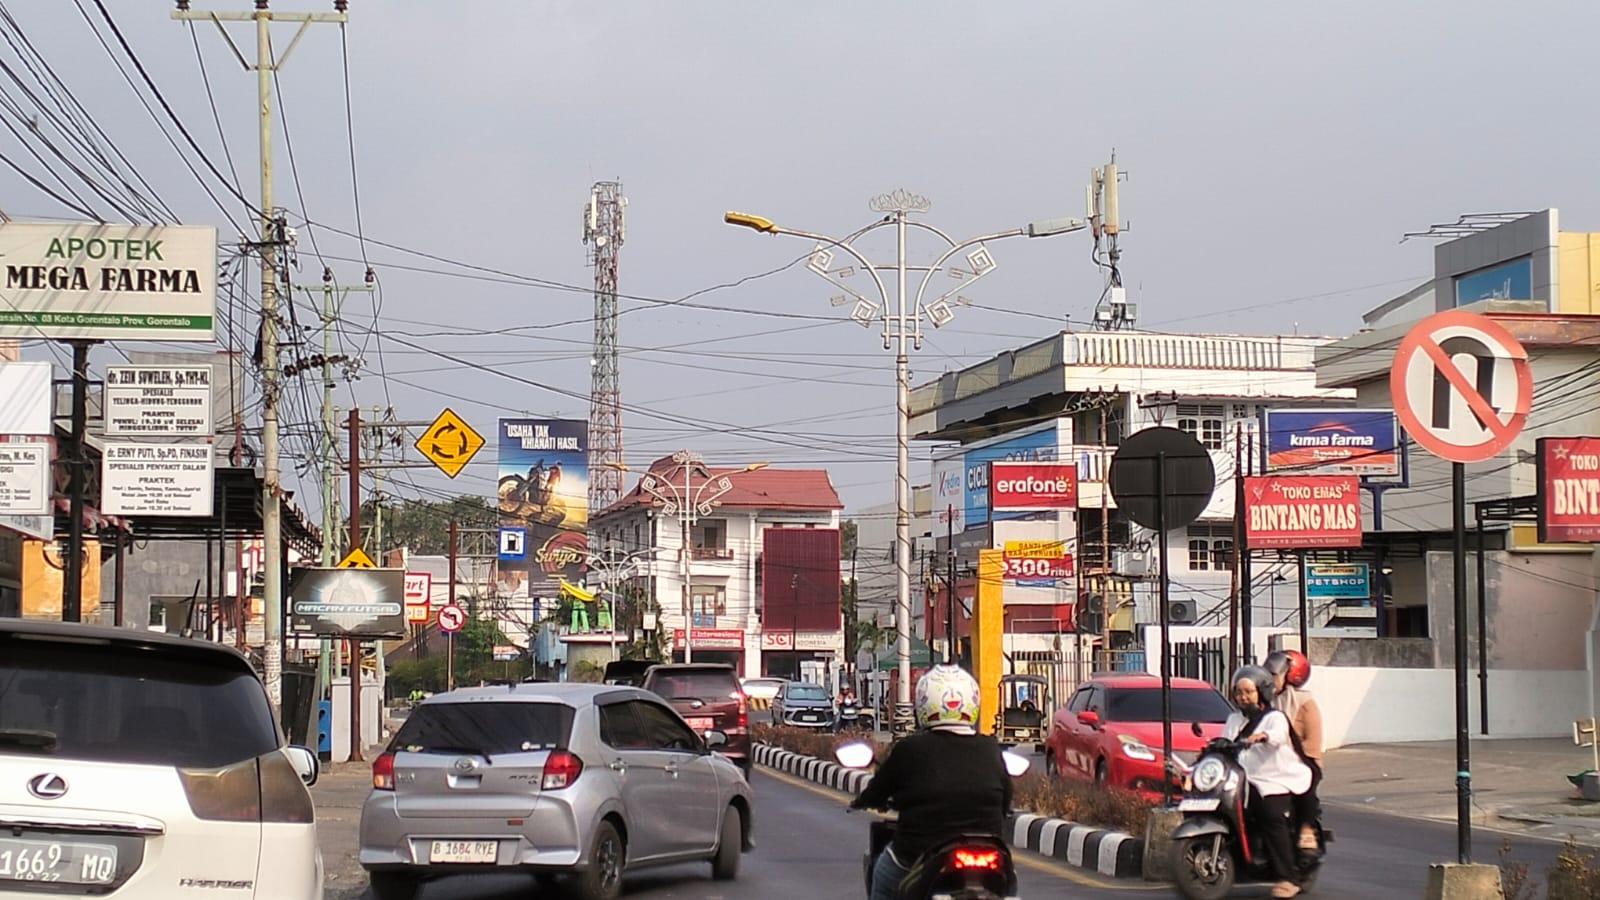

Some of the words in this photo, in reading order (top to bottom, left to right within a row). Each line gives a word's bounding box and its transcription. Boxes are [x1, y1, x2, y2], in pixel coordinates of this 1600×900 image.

[45, 238, 164, 261] APOTEK
[6, 265, 89, 290] MEGA
[100, 267, 201, 293] FARMA
[147, 317, 191, 327] Gorontalo
[1290, 434, 1328, 447] kimia
[1330, 433, 1374, 447] farma
[1570, 454, 1599, 470] TOKO
[996, 476, 1067, 493] erafone
[1282, 486, 1310, 499] TOKO
[1313, 485, 1343, 499] EMAS
[1250, 504, 1322, 531] BINTANG
[1323, 503, 1357, 530] MAS
[1051, 566, 1072, 577] ribu
[434, 842, 441, 855] B
[446, 842, 471, 855] 1684
[0, 844, 62, 875] 1669
[81, 855, 113, 881] MQ
